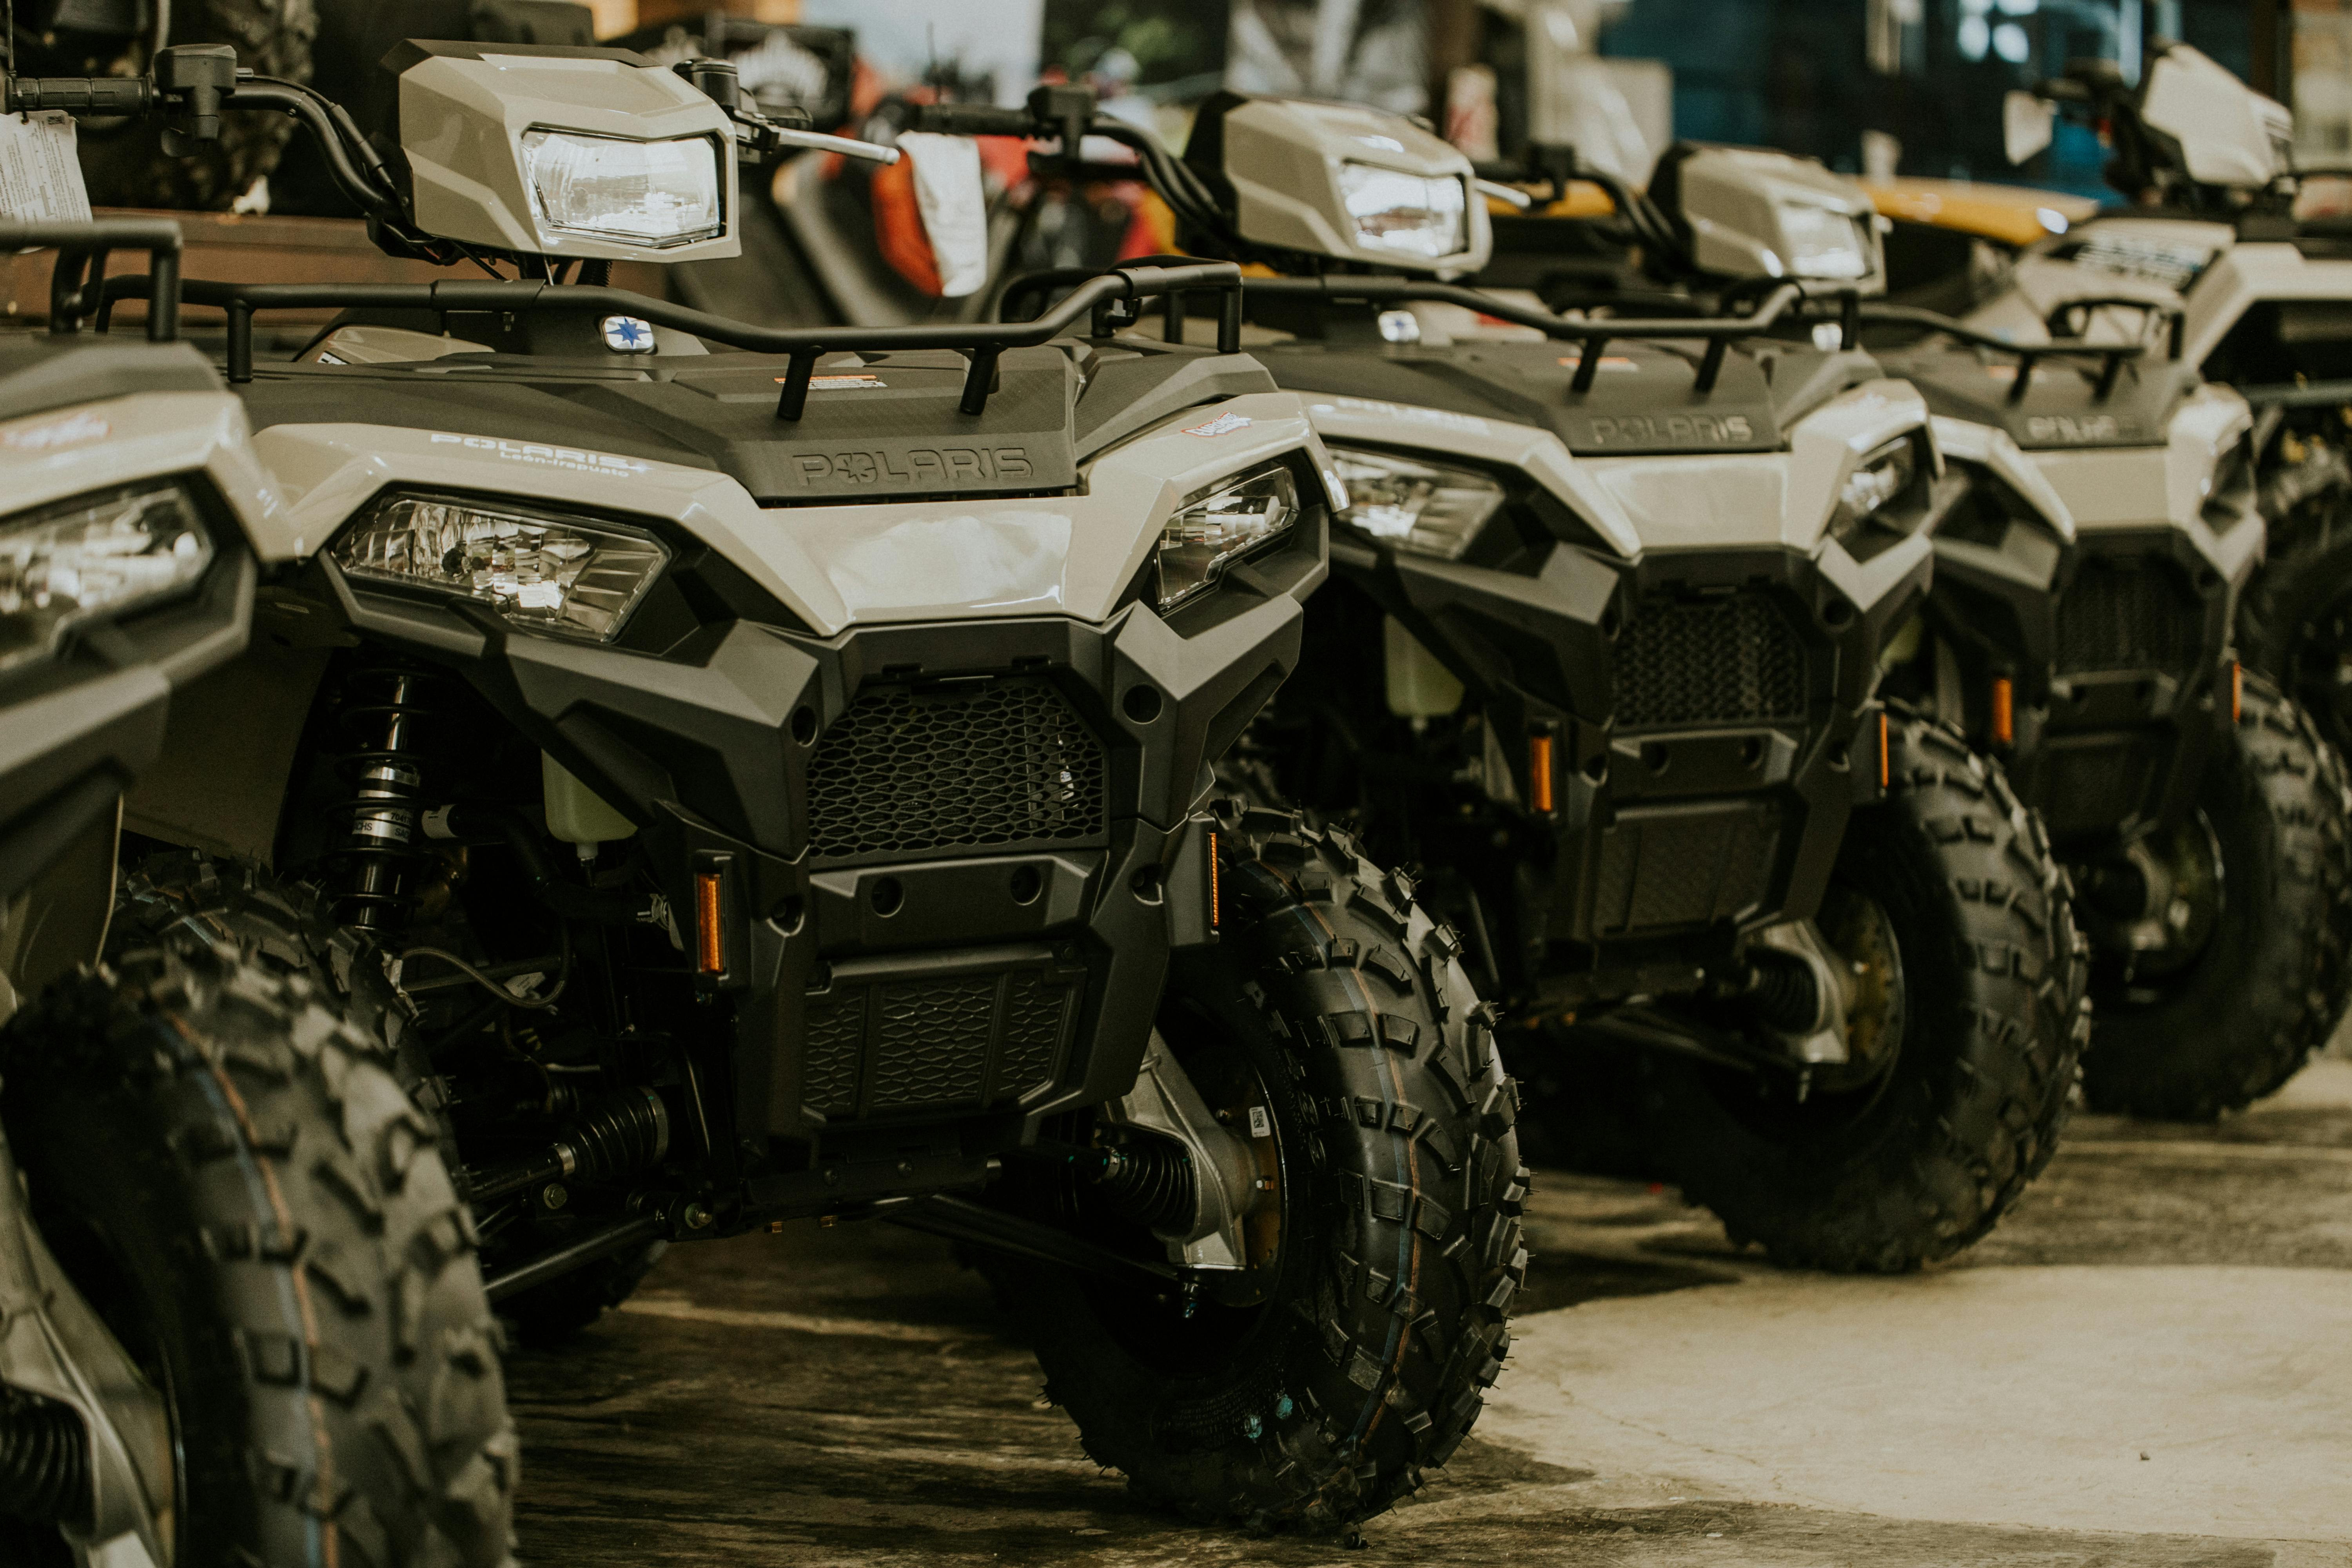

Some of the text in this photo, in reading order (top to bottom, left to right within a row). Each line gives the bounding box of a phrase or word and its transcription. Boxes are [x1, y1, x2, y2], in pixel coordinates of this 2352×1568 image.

[1588, 414, 1753, 444] POLARIS
[431, 434, 629, 469] POLARIS
[792, 448, 1033, 485] POLARIS
